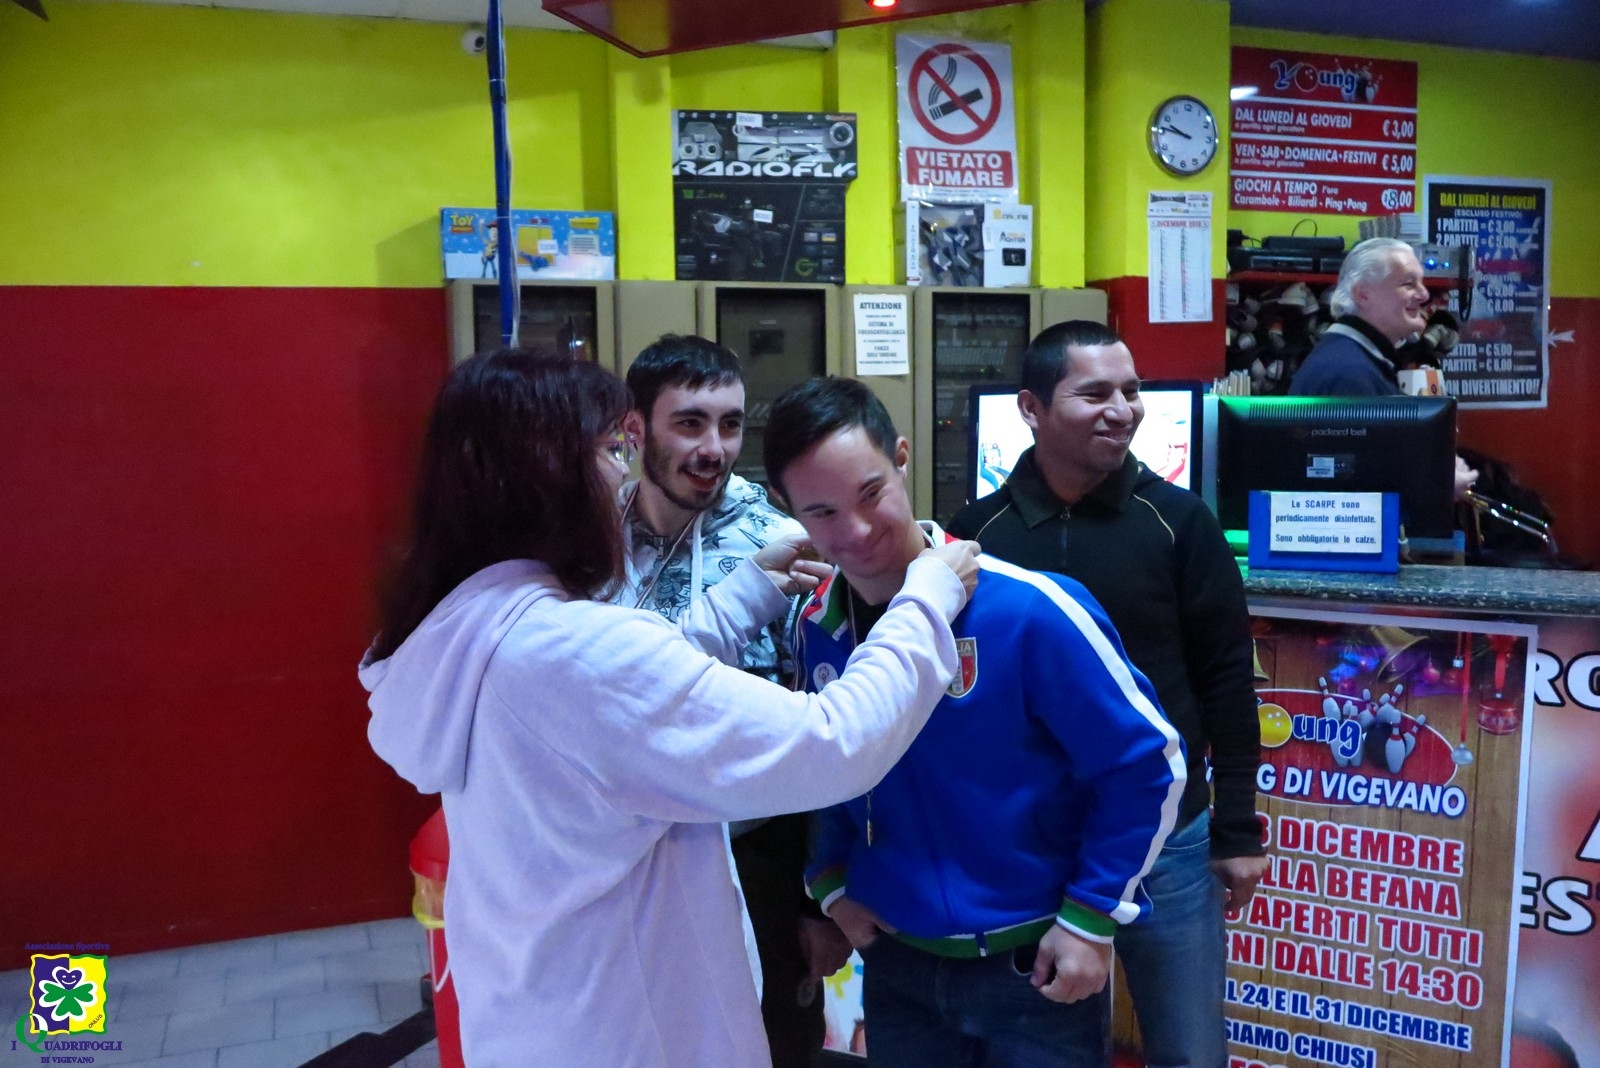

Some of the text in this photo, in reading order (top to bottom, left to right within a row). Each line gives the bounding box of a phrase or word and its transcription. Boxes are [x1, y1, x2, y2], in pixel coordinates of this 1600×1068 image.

[1235, 108, 1352, 128] DAL LUNEDÌ AL GIOVEDÌ
[915, 150, 1003, 169] VIETATO
[672, 160, 856, 177] RADIOFLY
[918, 169, 1004, 187] FUMARE
[1234, 178, 1272, 192] GIOCHI
[1274, 180, 1281, 193] A
[1284, 181, 1317, 195] TEMPO
[1440, 192, 1456, 207] DAL
[1459, 192, 1489, 208] LUNEDÌ
[1491, 194, 1500, 208] AL
[1443, 218, 1479, 232] PARTITA
[1443, 233, 1479, 248] PARTITE
[860, 302, 902, 310] ATTENZIONE
[1312, 428, 1366, 437] packard bell
[1292, 500, 1300, 508] Le
[1305, 500, 1335, 508] SCARPE
[1275, 514, 1329, 523] periodicamente
[1275, 534, 1292, 542] Sono
[1298, 535, 1339, 544] obbligatorie
[1344, 535, 1350, 543] le
[1283, 766, 1312, 797] DI
[1320, 770, 1467, 818] VIGEVANO
[1279, 817, 1462, 876] DICEMBRE
[1259, 856, 1459, 918] LLA BEFANA
[1249, 895, 1369, 945] APERTI
[1377, 915, 1481, 965] TUTTI
[1274, 940, 1372, 987] DALLE
[1380, 960, 1481, 1008] 14:30
[1242, 983, 1270, 1008] 24
[1275, 989, 1286, 1011] E
[1292, 993, 1309, 1016] IL
[1316, 998, 1342, 1023] 31
[1347, 1004, 1469, 1050] DICEMBRE
[1294, 1035, 1375, 1068] CHIUSI
